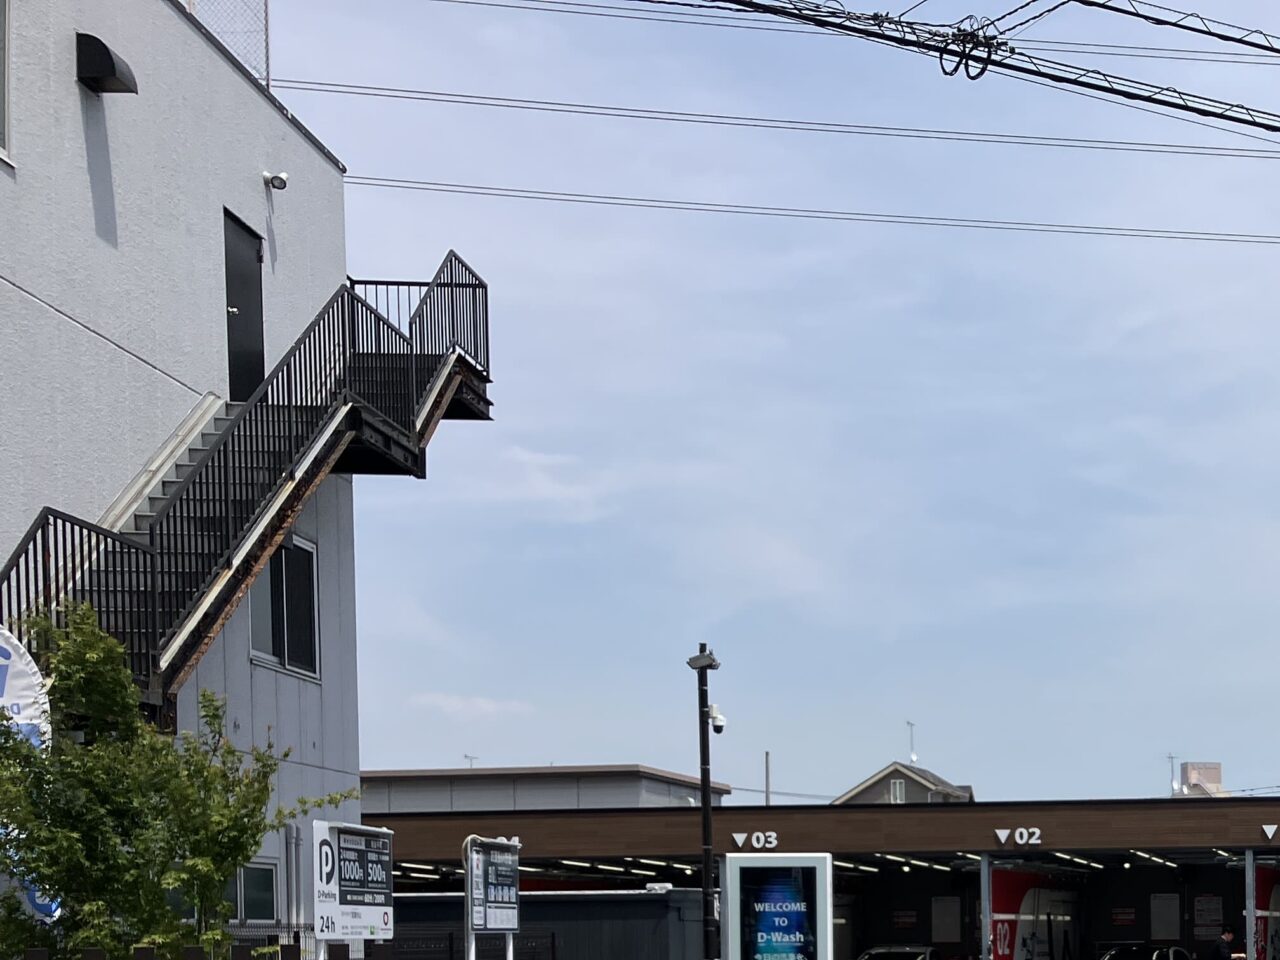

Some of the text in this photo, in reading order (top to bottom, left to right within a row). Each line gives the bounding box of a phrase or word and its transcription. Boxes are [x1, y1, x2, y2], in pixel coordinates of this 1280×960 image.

[751, 831, 778, 849] 03
[1014, 827, 1042, 845] 02
[754, 902, 807, 912] WELCOME
[773, 917, 788, 926] TO
[757, 931, 804, 942] D-Wash
